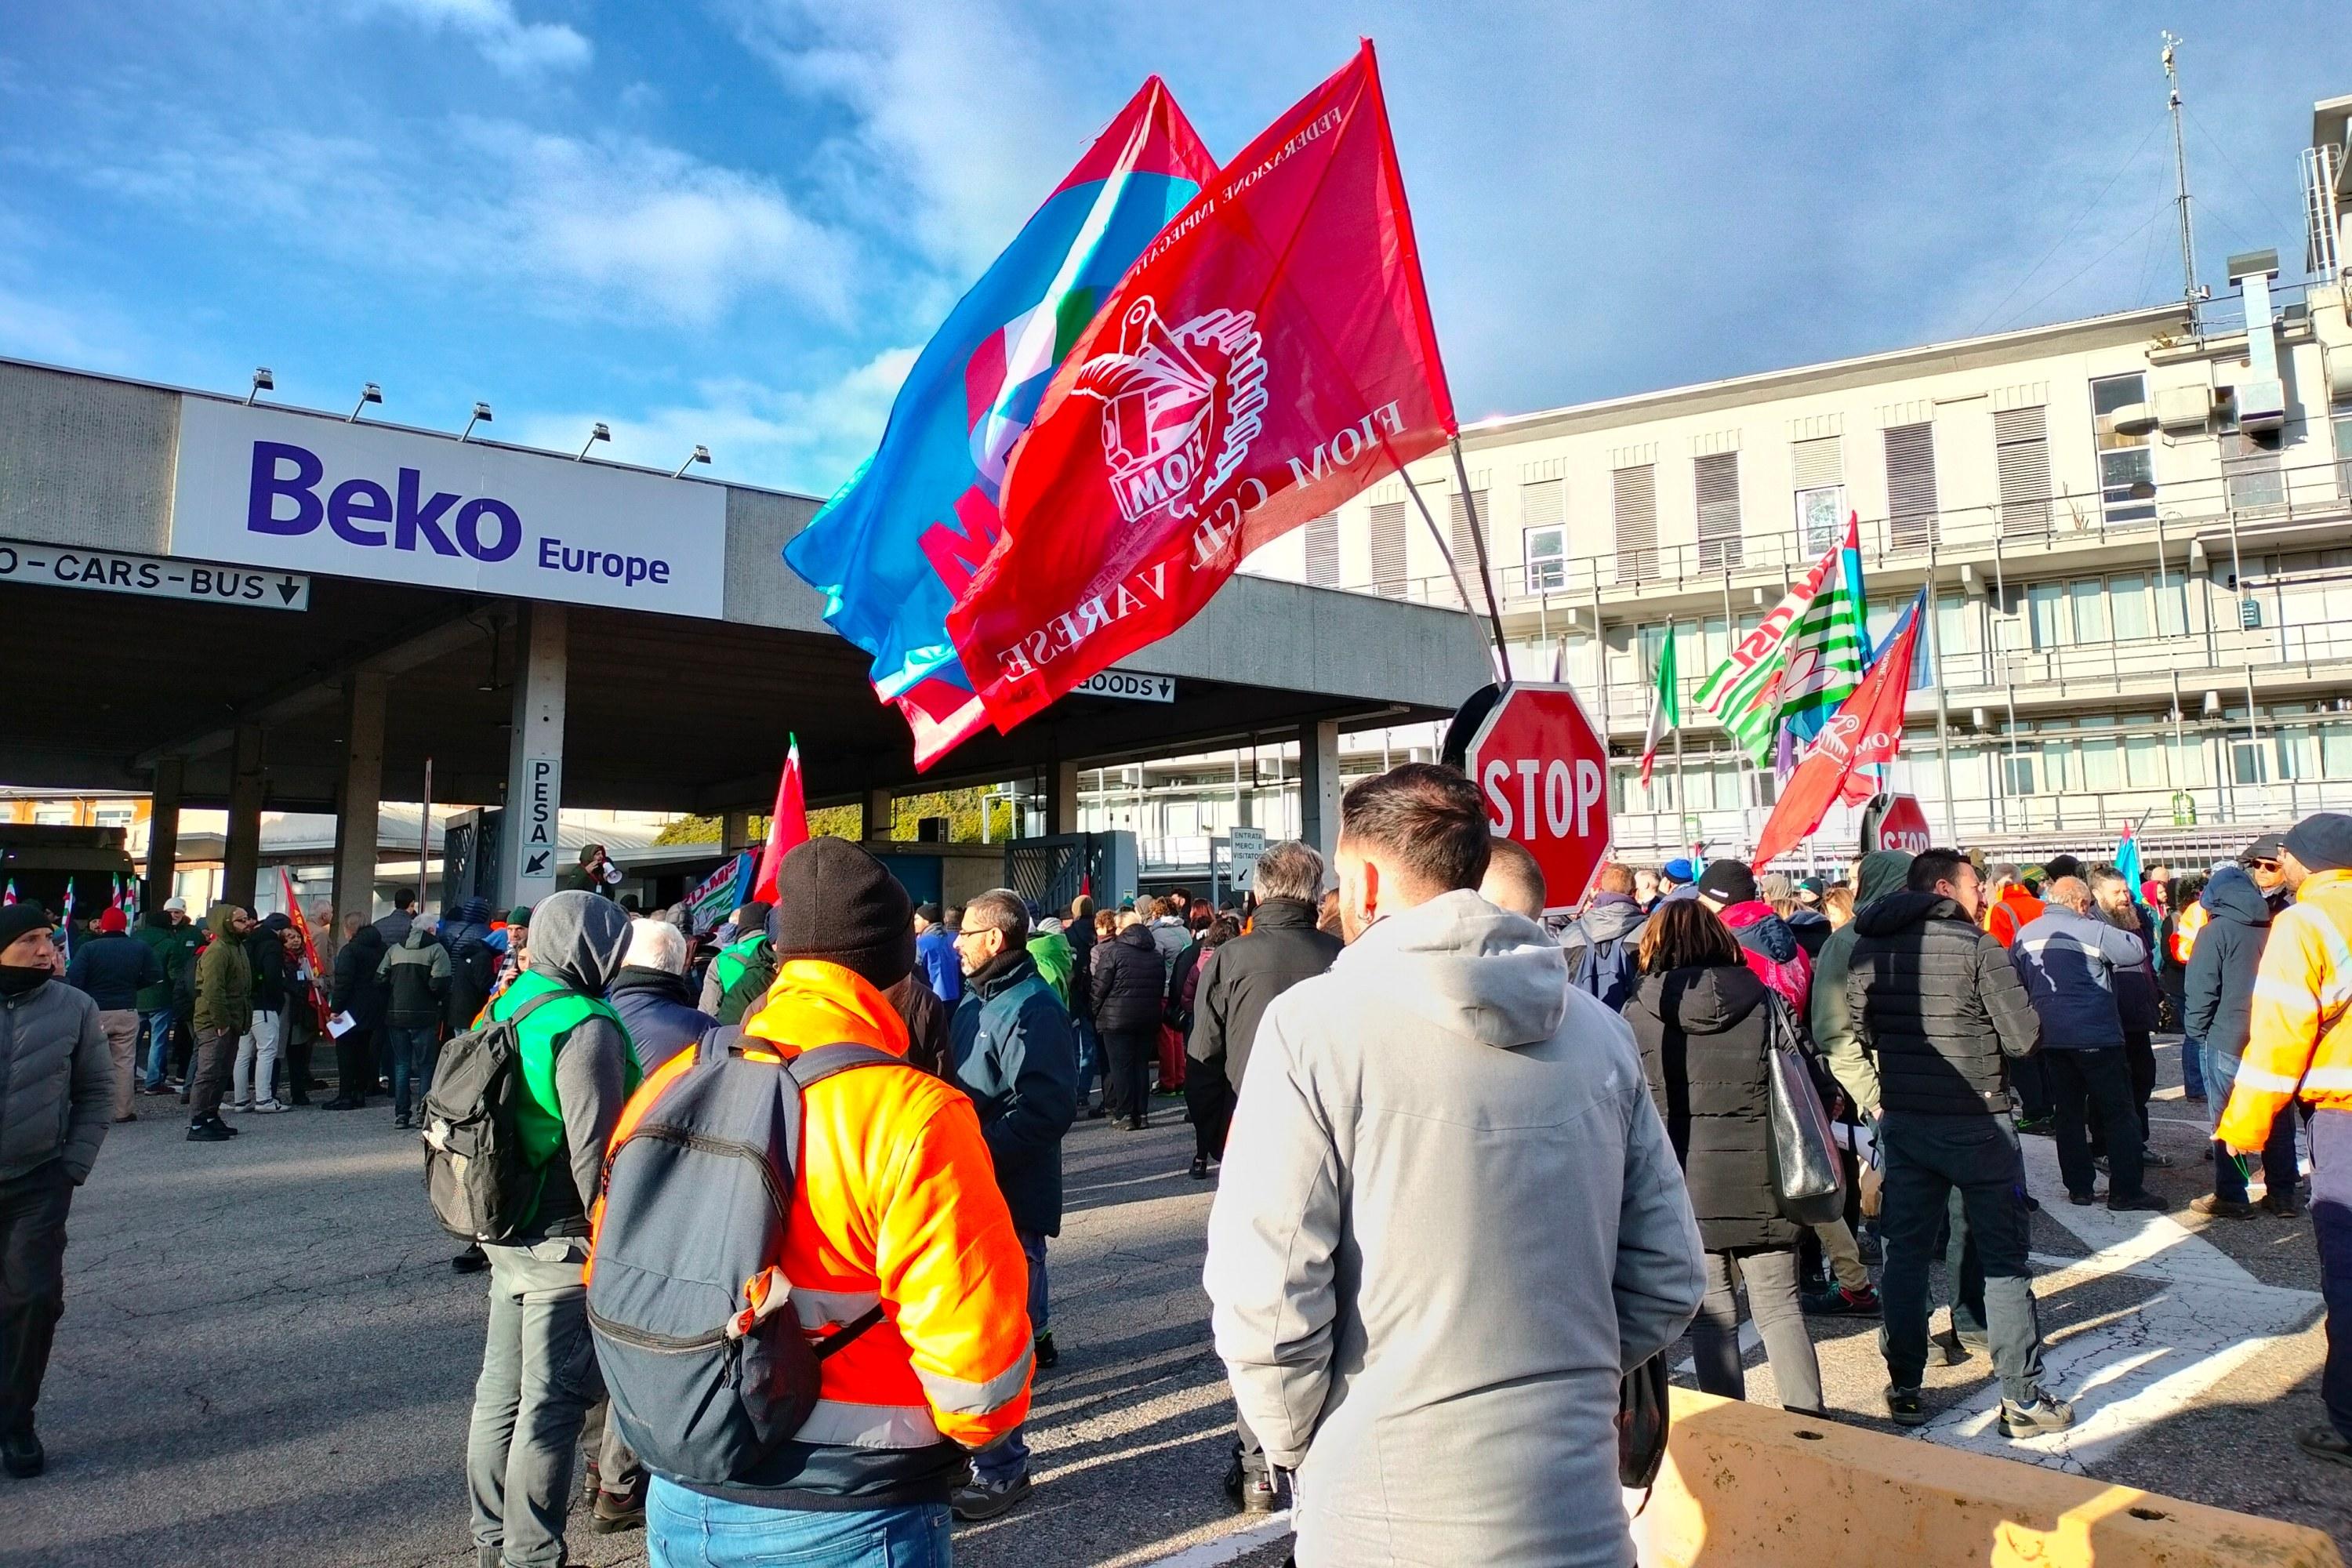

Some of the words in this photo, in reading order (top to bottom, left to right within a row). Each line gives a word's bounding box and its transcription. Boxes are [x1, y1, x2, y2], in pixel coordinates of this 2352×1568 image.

[246, 440, 523, 563] Beko
[537, 536, 670, 587] Europe
[530, 762, 550, 843] PESA
[1483, 758, 1602, 840] STOP
[1232, 851, 1261, 860] VISITATO
